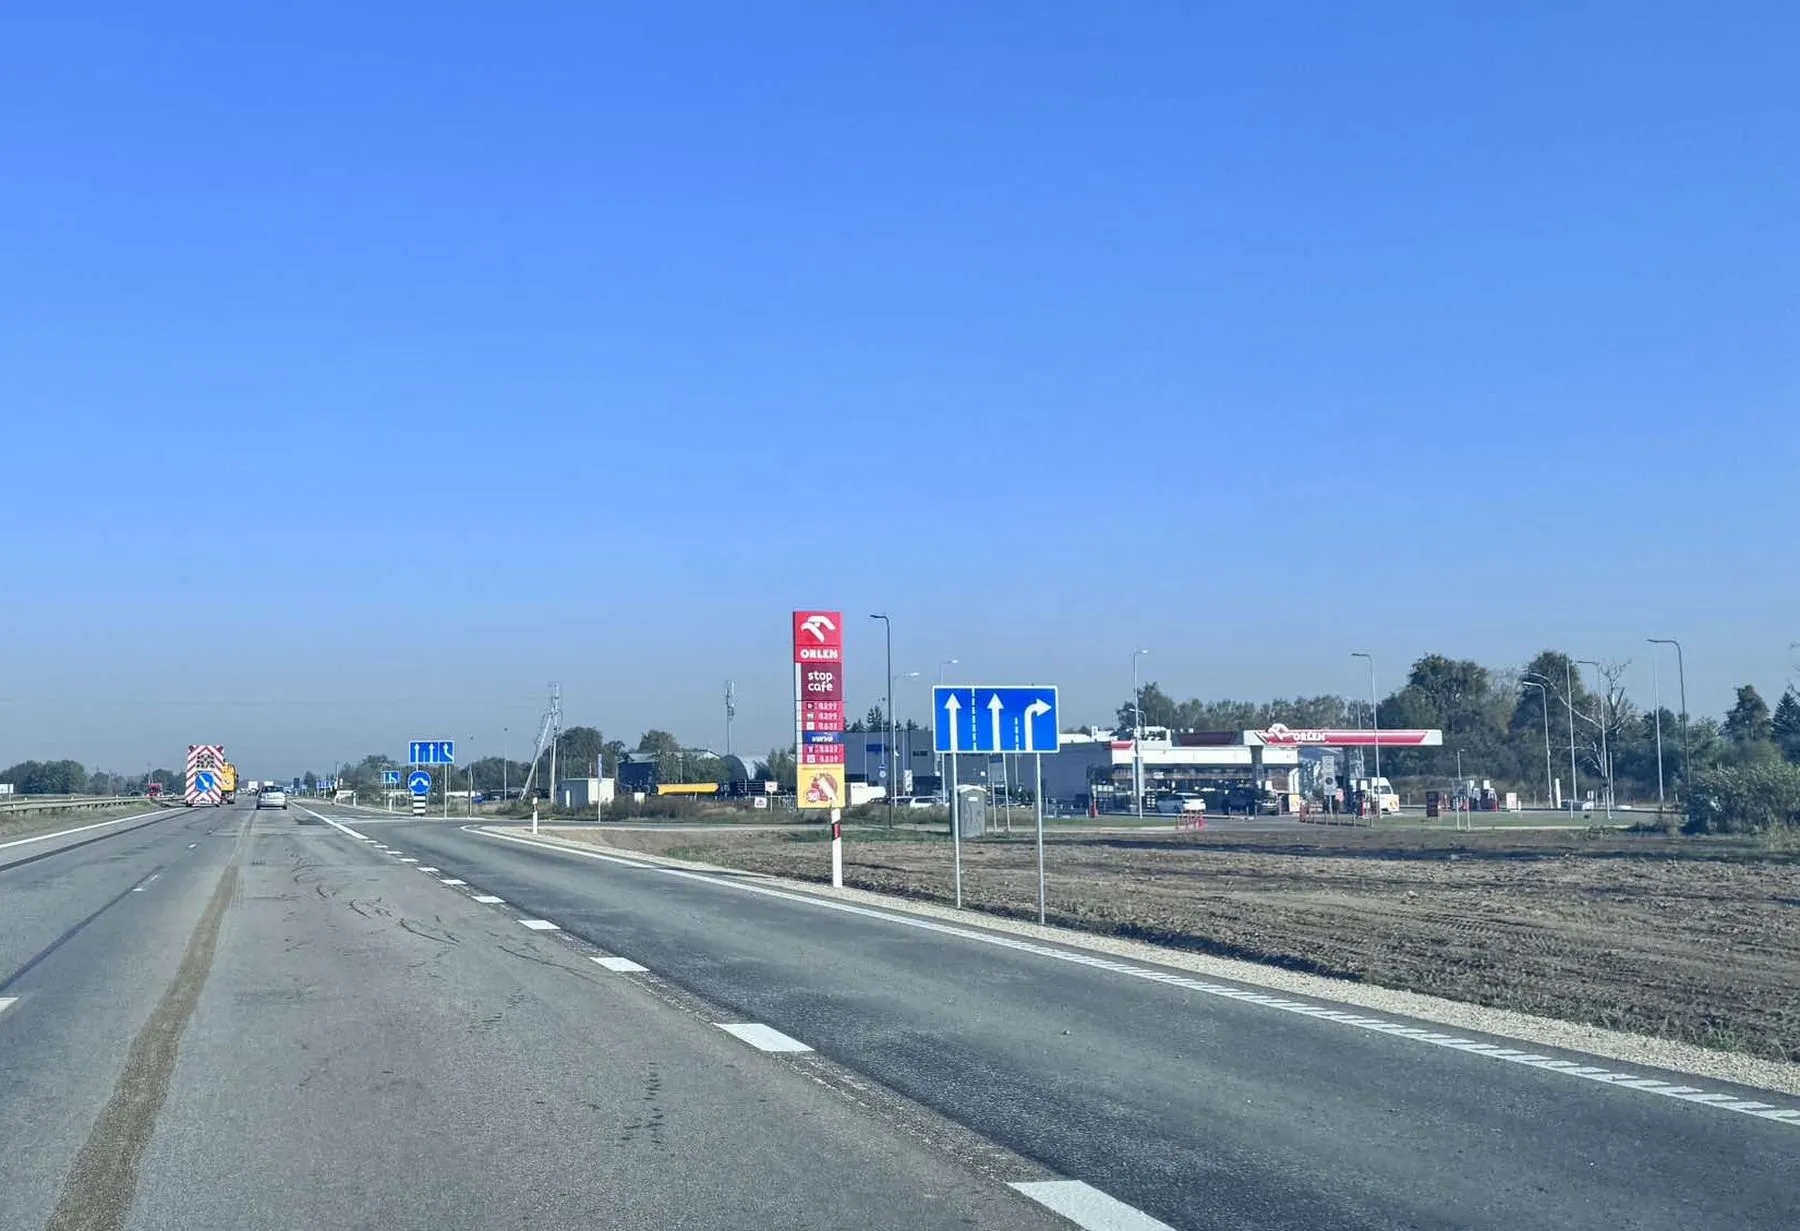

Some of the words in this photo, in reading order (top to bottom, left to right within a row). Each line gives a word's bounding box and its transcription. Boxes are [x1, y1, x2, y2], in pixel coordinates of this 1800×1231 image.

[800, 649, 838, 659] ORLEN
[808, 671, 833, 682] stop
[808, 681, 833, 692] cafe
